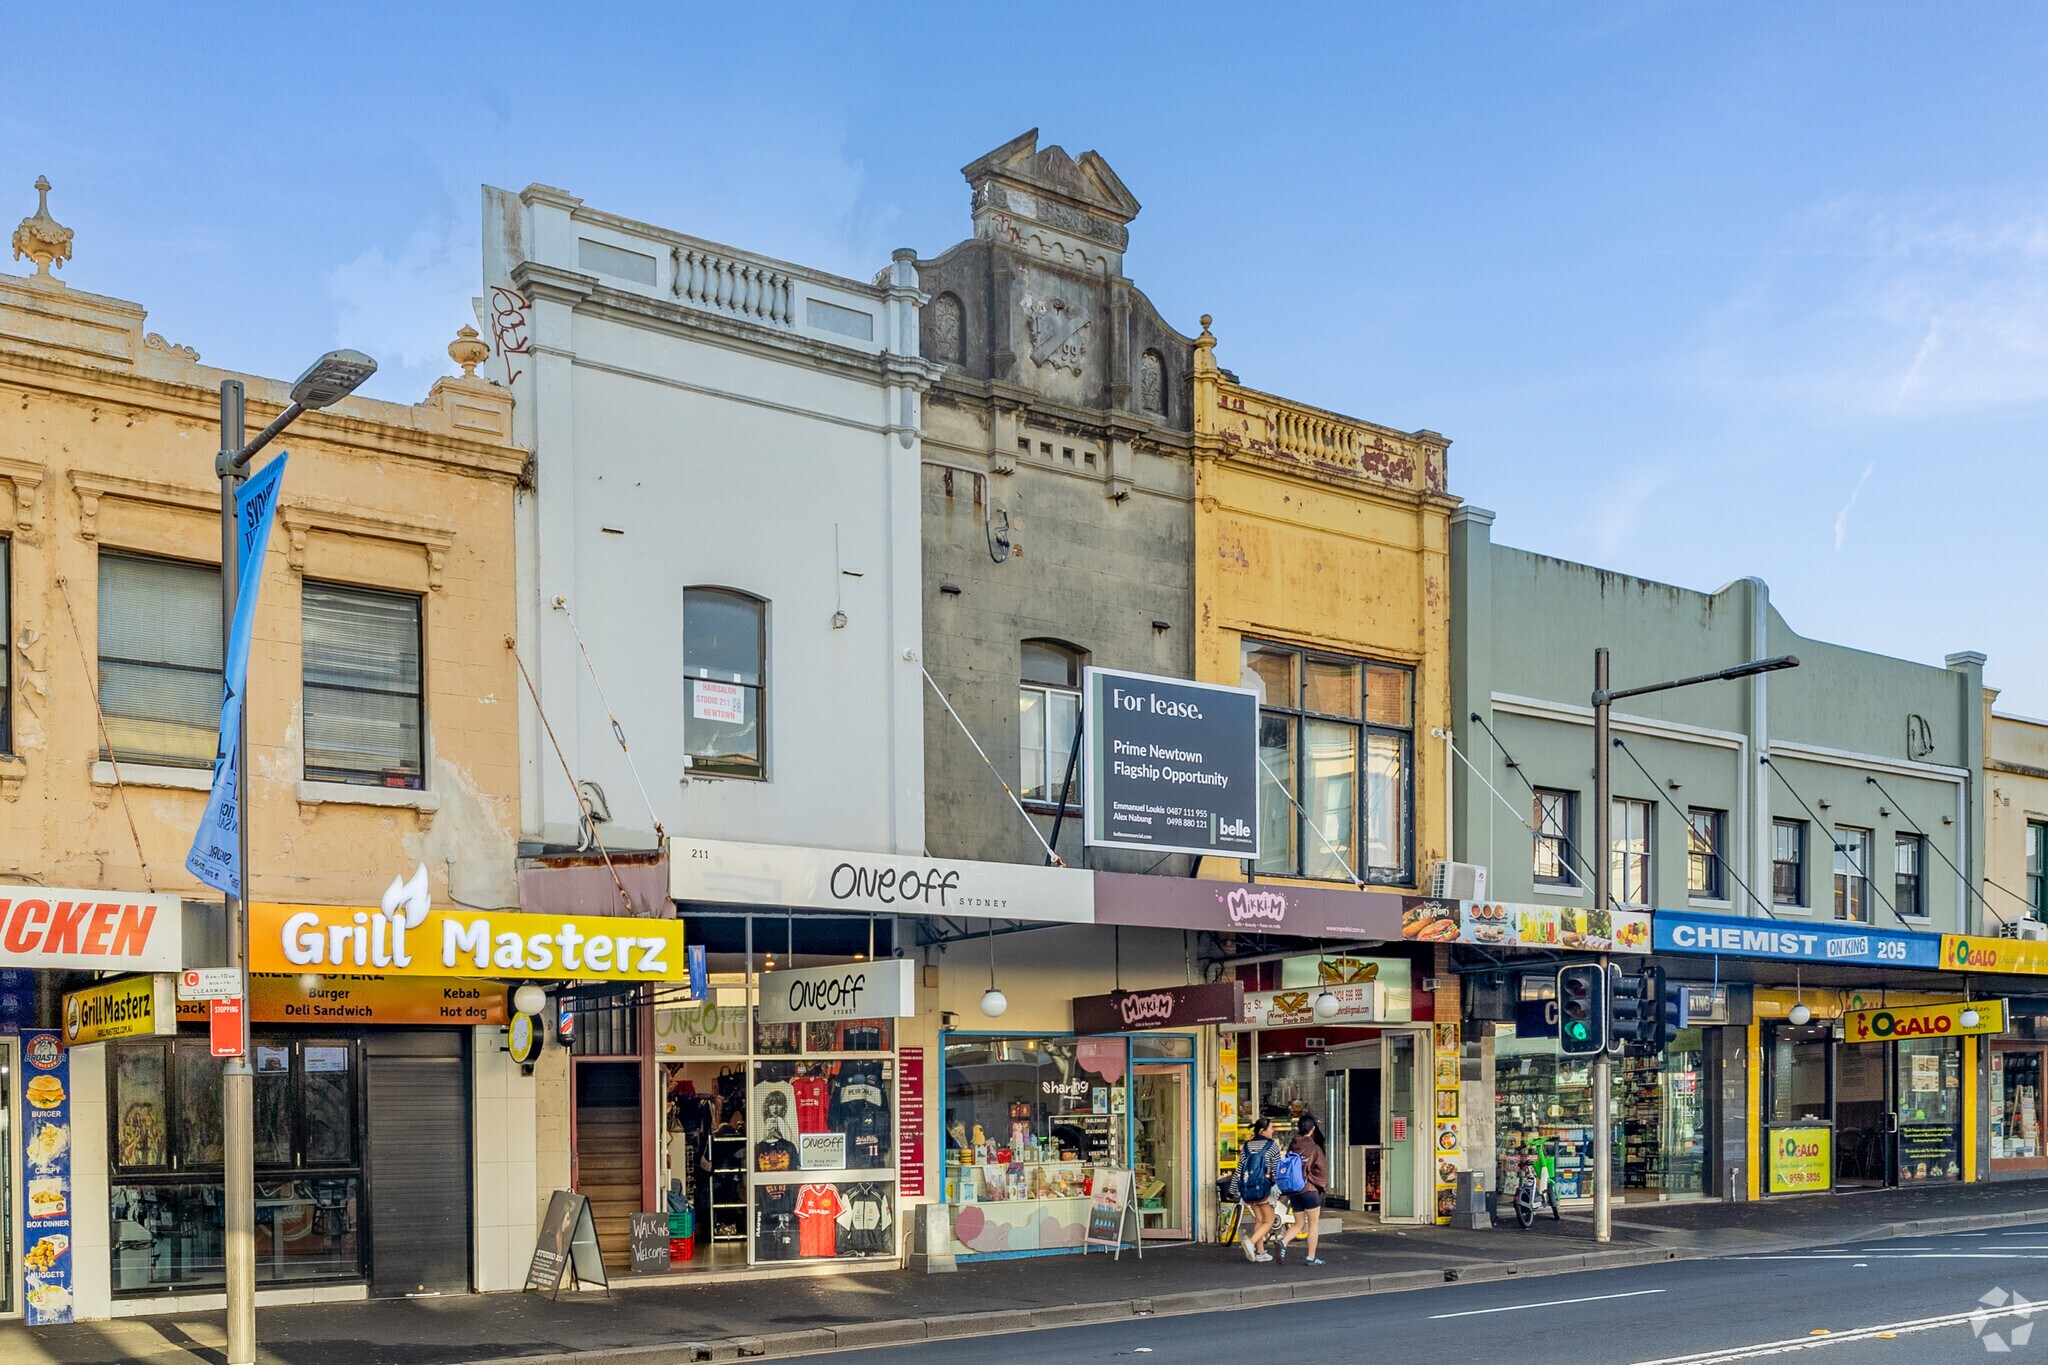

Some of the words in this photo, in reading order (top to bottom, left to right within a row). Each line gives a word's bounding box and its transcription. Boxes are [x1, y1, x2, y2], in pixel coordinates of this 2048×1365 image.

[702, 684, 737, 695] HAIRSALON
[695, 695, 718, 706] STUDIO
[719, 697, 730, 707] 211
[1113, 688, 1146, 712] For
[1150, 693, 1203, 720] lease.
[703, 708, 736, 720] NEWTOWN
[1113, 740, 1147, 757] Prime
[1149, 744, 1203, 763] Newtown
[1113, 761, 1160, 781] Flagship
[1162, 766, 1229, 789] Opportunity
[1113, 801, 1146, 813] Emmanuel
[1166, 806, 1182, 816] 0487
[1183, 807, 1195, 817] 111
[1113, 812, 1128, 822] Alex
[1128, 813, 1153, 825] Nabung
[1166, 817, 1182, 827] 0498
[1183, 818, 1195, 828] 880
[1196, 819, 1208, 829] 121
[1220, 817, 1251, 837] belle
[691, 849, 709, 860] 211
[959, 897, 1009, 909] SYDNEY
[280, 912, 413, 969] Grill
[442, 919, 668, 974] Masterz
[1672, 924, 1818, 956] CHEMIST
[1829, 939, 1843, 954] ON
[1844, 937, 1868, 954] KING
[1877, 941, 1907, 960] 205
[1956, 940, 1997, 968] OGALO
[187, 972, 197, 986] C
[308, 988, 351, 1002] Burger
[443, 988, 480, 1000] Kebab
[81, 995, 103, 1028] Grill
[104, 991, 151, 1025] Masterz
[215, 1006, 239, 1014] STOPPING
[285, 1003, 312, 1016] Deli
[314, 1004, 373, 1018] Sandwich
[440, 1005, 462, 1018] Hot
[463, 1005, 488, 1020] dog
[833, 1008, 857, 1016] SYDNEY
[1871, 1011, 1952, 1037] OGALO
[691, 1036, 707, 1045] 211
[25, 1053, 67, 1062] BROASTER
[31, 1110, 62, 1118] BURGER
[868, 1145, 879, 1156] 11
[1786, 1138, 1819, 1157] OGALO
[34, 1166, 61, 1175] CRISPY
[43, 1220, 70, 1228] DINNER
[632, 1215, 657, 1240] WALK
[632, 1243, 669, 1264] WELCOME
[30, 1271, 65, 1279] NUGGETS
